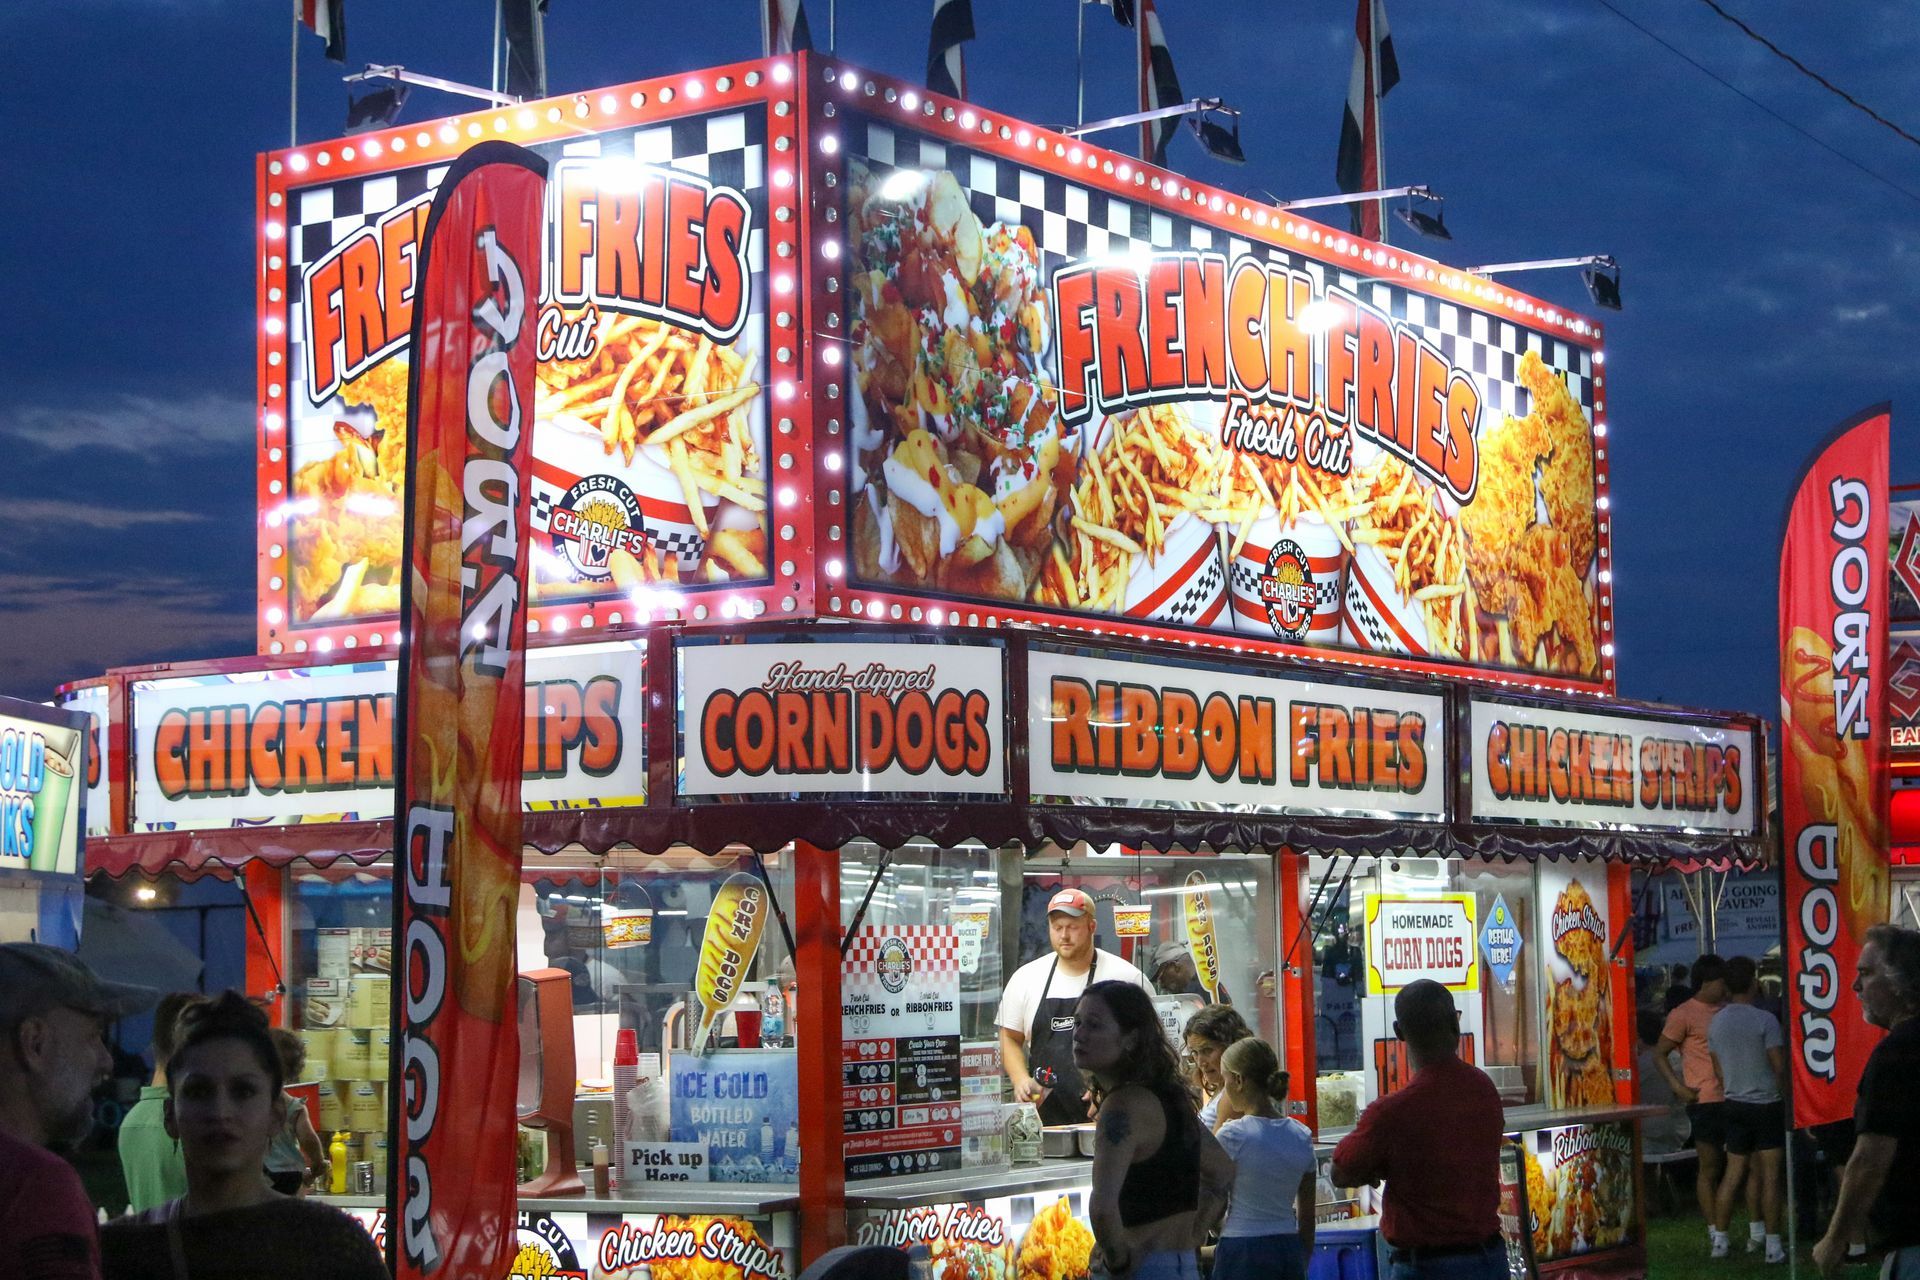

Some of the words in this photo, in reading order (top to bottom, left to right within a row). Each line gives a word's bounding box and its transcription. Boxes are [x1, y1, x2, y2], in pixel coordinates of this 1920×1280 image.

[555, 157, 752, 346] FRIES
[535, 304, 601, 363] Cut
[1053, 249, 1317, 428] FRENCH
[1322, 284, 1483, 509] FRIES
[1221, 391, 1299, 466] Fresh
[1303, 413, 1352, 478] Cut
[570, 476, 616, 500] FRESH
[619, 487, 641, 517] CUT
[553, 511, 643, 554] CHARLIE'S
[1269, 541, 1293, 566] FRESH
[1295, 548, 1310, 572] CUT
[1263, 580, 1315, 604] CHARLIE'S
[1268, 608, 1294, 639] FRENCH
[1295, 613, 1311, 640] FRIES
[763, 660, 935, 697] Hand-dipped
[154, 693, 397, 801] CHICKEN
[524, 675, 624, 779] IPS
[700, 688, 852, 777] CORN
[855, 688, 990, 777] DOGS
[1050, 675, 1276, 786] RIBBON
[1289, 700, 1427, 795] FRIES
[0, 728, 45, 793] OLD
[1487, 720, 1634, 808] CHICKEN
[1640, 736, 1742, 815] STRIPS
[1731, 885, 1777, 897] GOING
[731, 887, 760, 942] CORN
[1392, 914, 1453, 929] HOMEMADE
[1553, 901, 1581, 941] Chicken
[1582, 903, 1605, 942] Strips
[1384, 937, 1422, 970] CORN
[1426, 936, 1463, 969] DOGS
[1487, 928, 1514, 945] REFILLS
[1490, 947, 1512, 964] HERE!
[877, 960, 911, 970] CHARLIE'S
[1203, 933, 1217, 980] DOGS
[712, 949, 742, 1004] DOGS
[865, 1004, 886, 1015] FRIES
[890, 1008, 900, 1017] OR
[906, 1003, 934, 1013] RIBBON
[934, 1001, 953, 1012] FRIES
[675, 1071, 707, 1098] ICE
[714, 1071, 768, 1099] COLD
[690, 1105, 753, 1125] BOTTLED
[697, 1128, 748, 1148] WATER
[1555, 1127, 1598, 1168] Ribbon
[1600, 1122, 1633, 1155] Fries
[631, 1149, 673, 1166] Pick
[678, 1151, 703, 1170] up
[645, 1168, 689, 1181] Here
[536, 1217, 571, 1255] CUT
[857, 1208, 941, 1249] Ribbon
[944, 1202, 1004, 1247] Fries
[599, 1213, 697, 1273] Chicken
[699, 1221, 783, 1280] Strips
